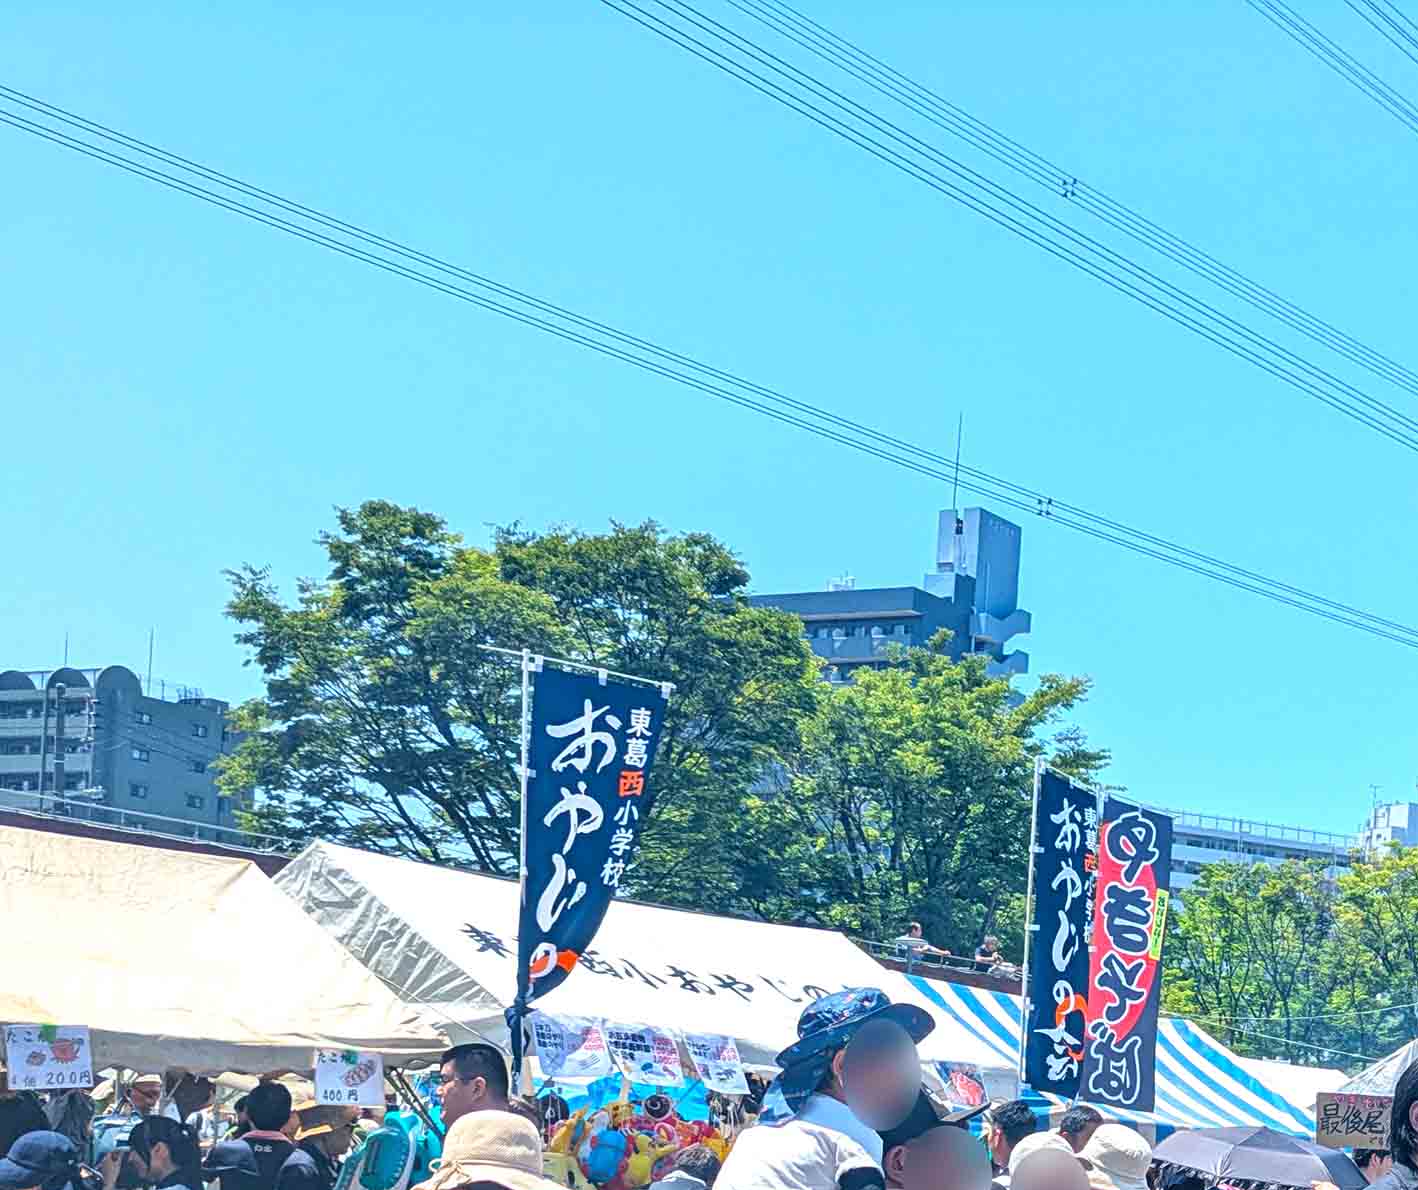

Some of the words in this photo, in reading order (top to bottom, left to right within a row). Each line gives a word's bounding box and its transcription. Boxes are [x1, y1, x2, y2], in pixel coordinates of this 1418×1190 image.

[527, 698, 622, 998] おやじの
[600, 707, 652, 888] 東葛西小学校
[1033, 797, 1083, 1081] おやじの会
[1320, 1103, 1385, 1136] 最後尾
